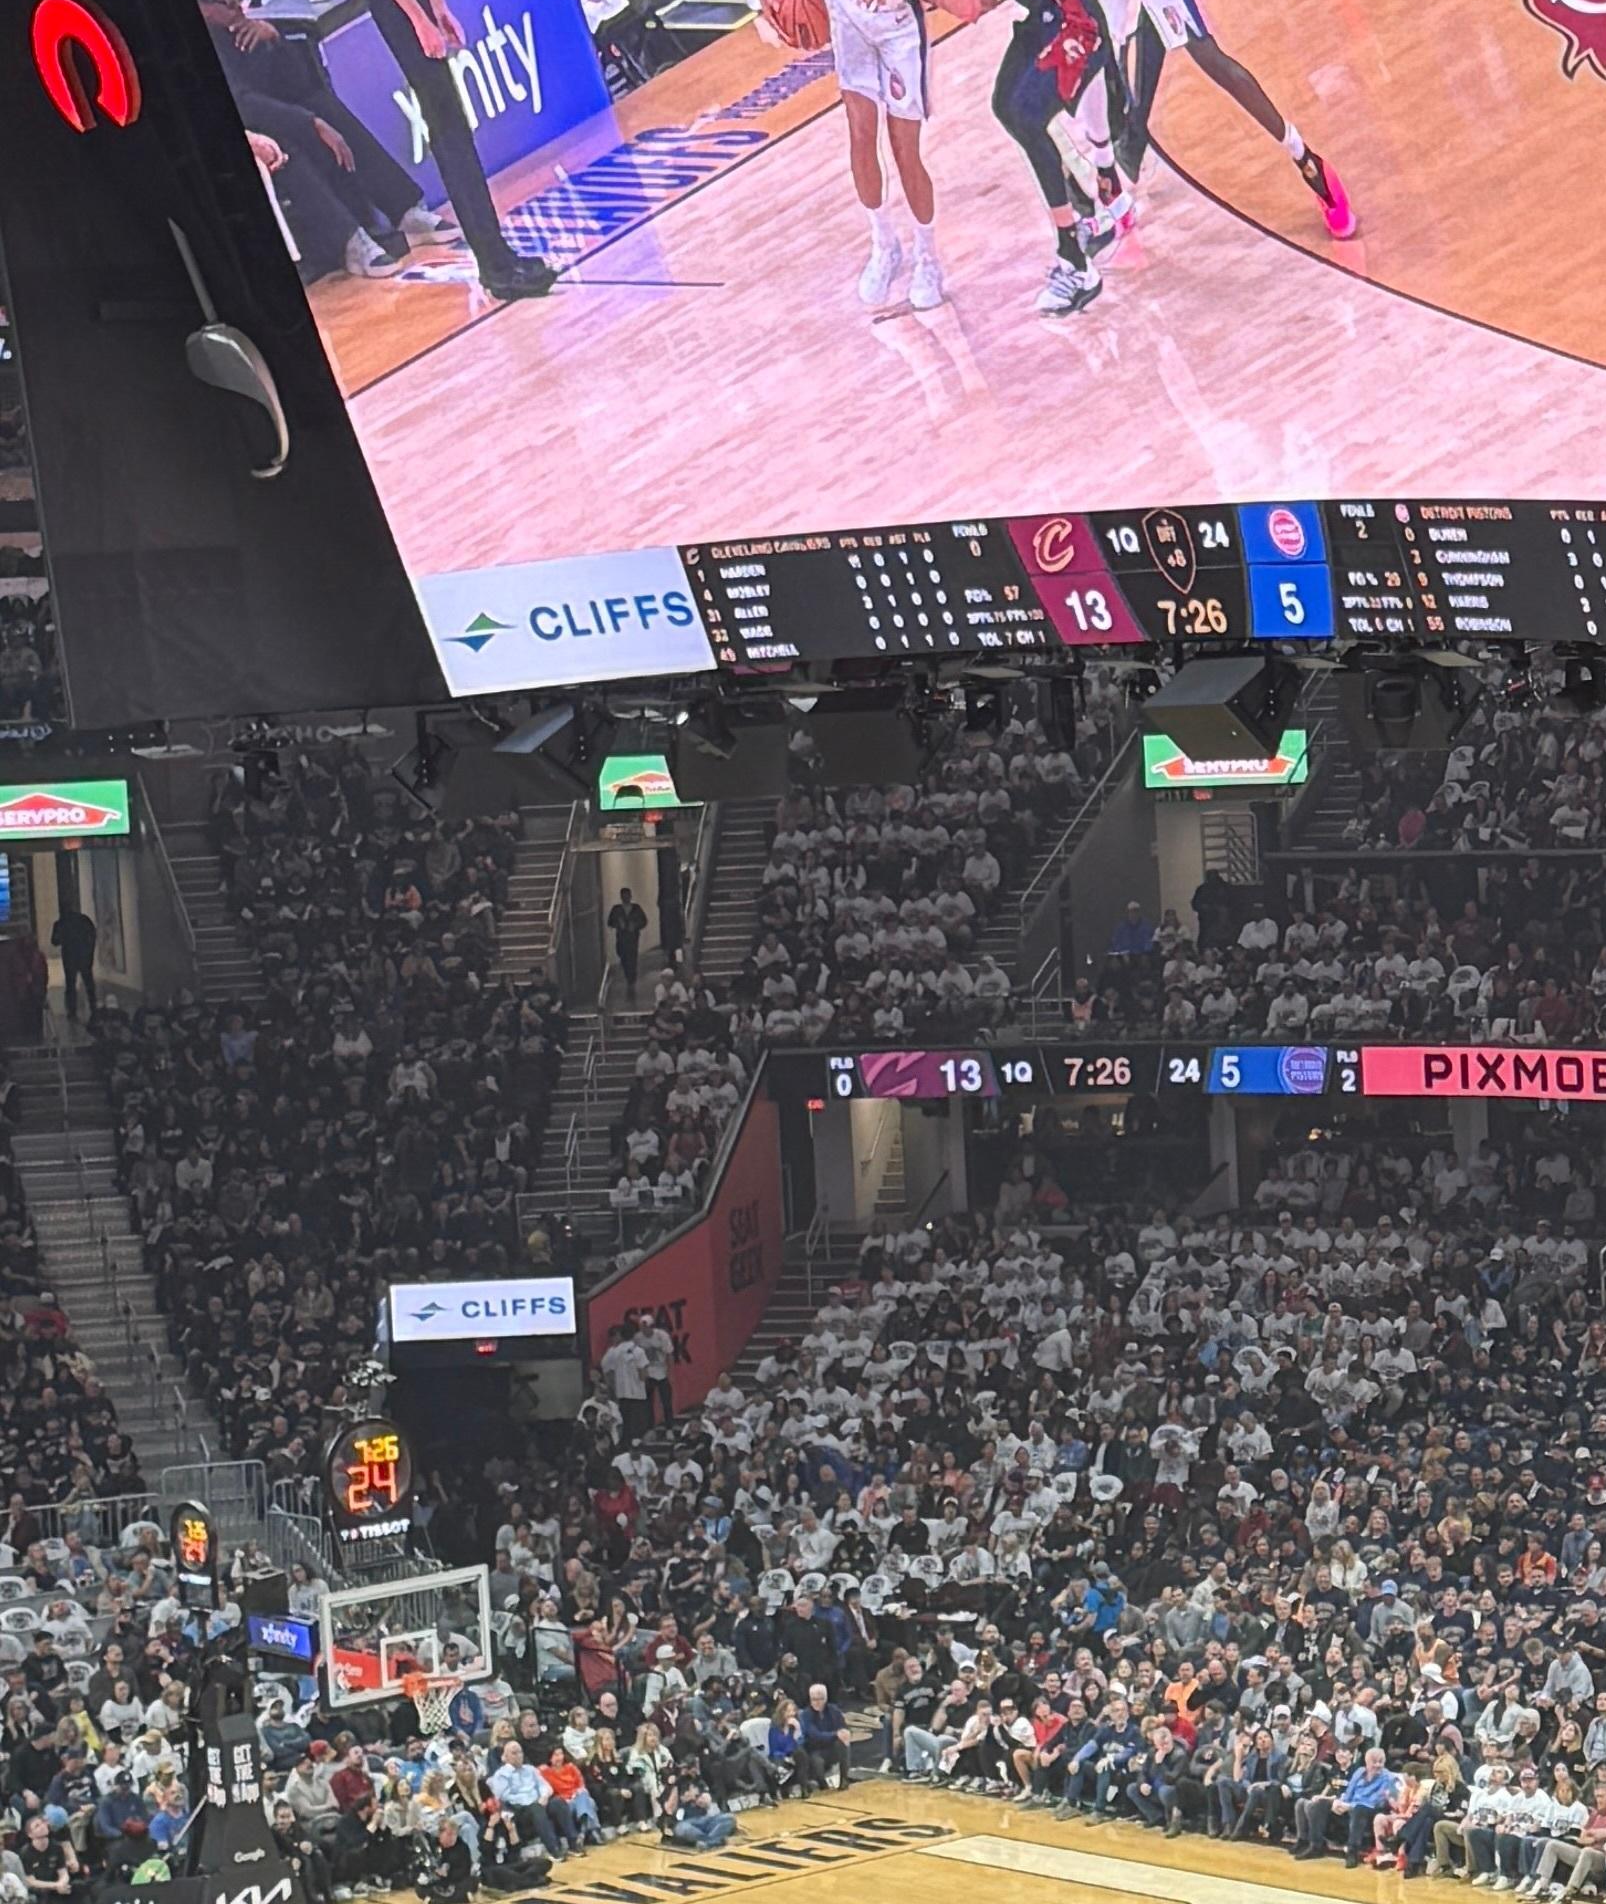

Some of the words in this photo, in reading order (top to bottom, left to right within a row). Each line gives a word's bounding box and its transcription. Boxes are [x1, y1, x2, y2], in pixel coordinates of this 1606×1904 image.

[393, 4, 543, 165] xnity
[1106, 527, 1141, 553] 1Q
[1199, 521, 1229, 548] 24
[529, 591, 695, 642] CLIFFS
[1064, 589, 1112, 631] 13
[1158, 599, 1227, 634] 7:26
[1279, 583, 1305, 624] 5
[837, 1074, 852, 1095] 0
[940, 1059, 982, 1092] 13
[1001, 1063, 1031, 1083] 1Q
[1065, 1059, 1131, 1086] 7:26
[1169, 1059, 1200, 1083] 24
[1221, 1056, 1240, 1088] 5
[1342, 1070, 1356, 1091] 2
[462, 1296, 567, 1321] CLIFFS
[354, 1436, 398, 1463] 7:26
[347, 1465, 397, 1511] 24
